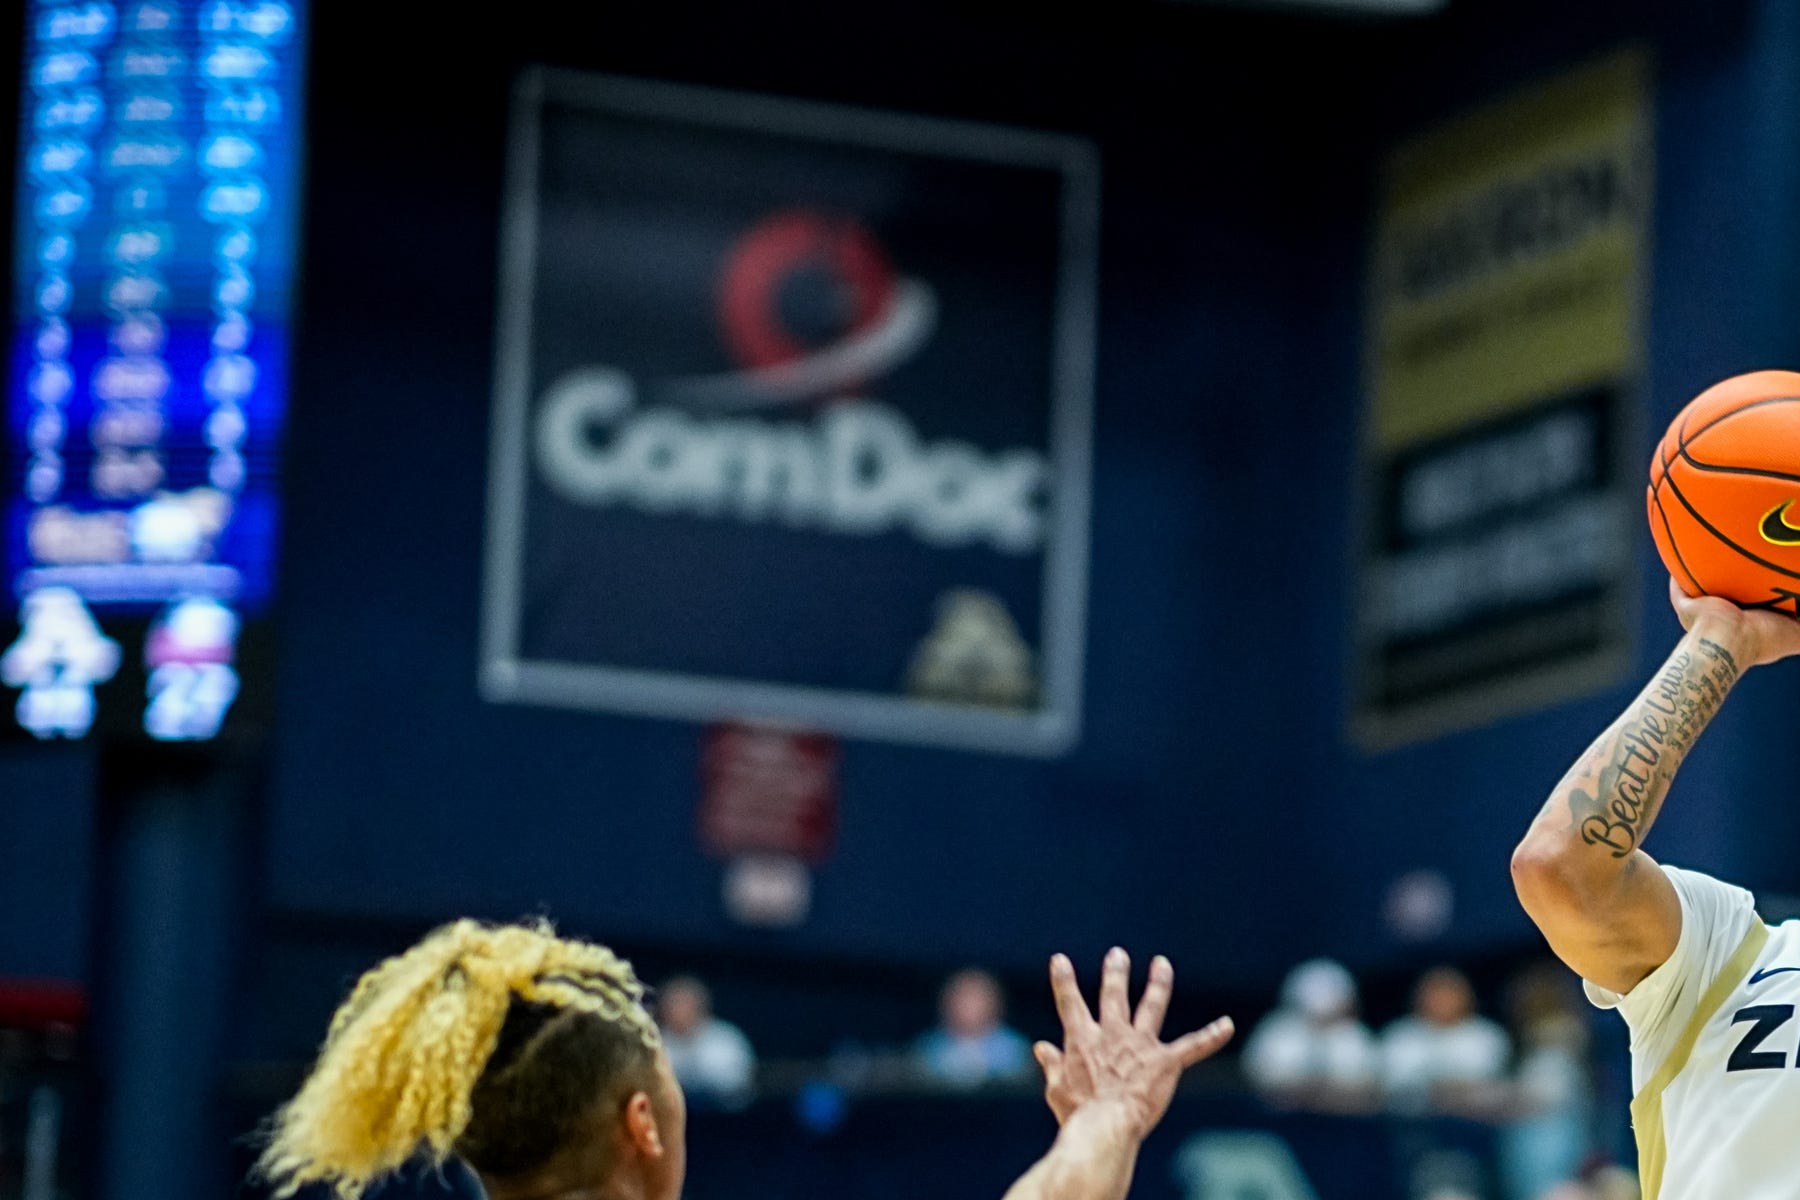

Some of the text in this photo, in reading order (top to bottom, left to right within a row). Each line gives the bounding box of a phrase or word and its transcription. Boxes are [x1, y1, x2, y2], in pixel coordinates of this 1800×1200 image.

[537, 366, 1048, 552] ComDoc
[1581, 756, 1649, 858] Beat
[1624, 714, 1669, 766] the
